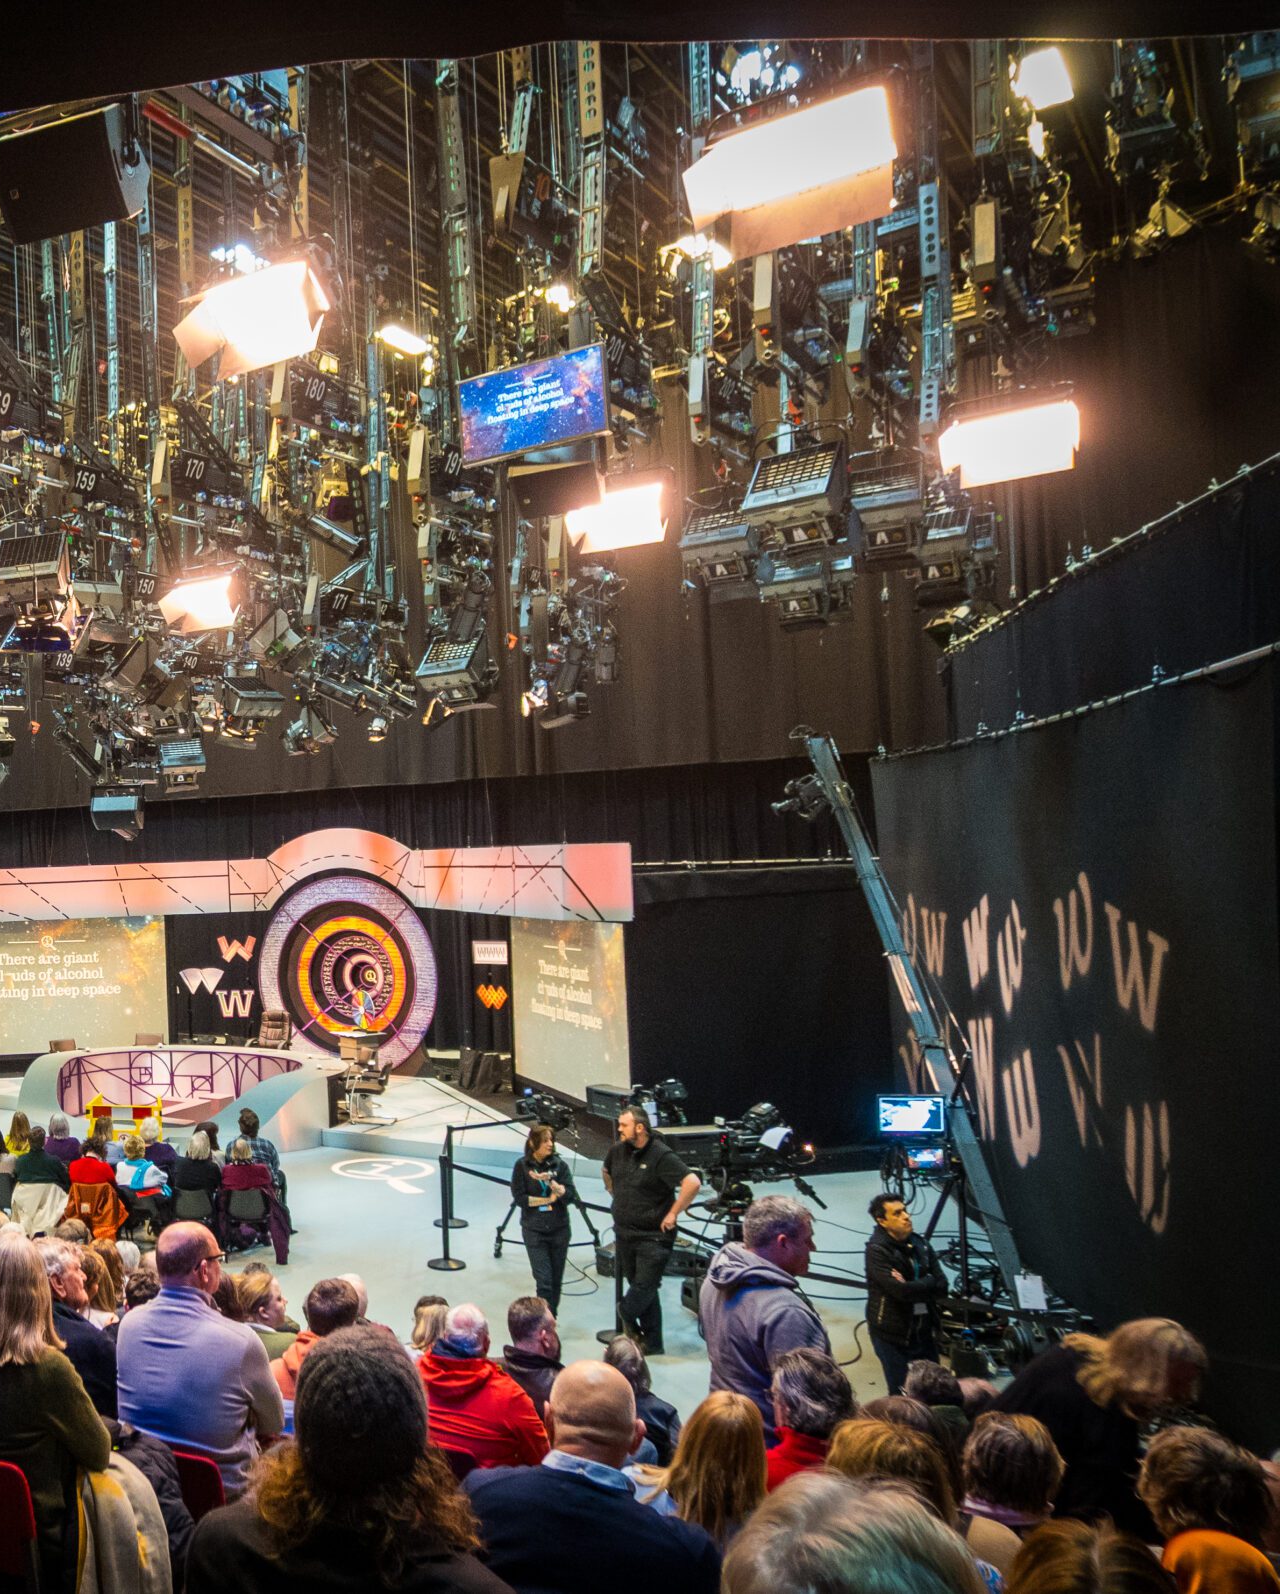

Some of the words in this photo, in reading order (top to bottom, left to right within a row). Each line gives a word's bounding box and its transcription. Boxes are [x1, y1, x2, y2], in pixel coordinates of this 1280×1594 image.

[305, 377, 326, 401] 180
[496, 400, 522, 412] cluds
[524, 396, 533, 406] of
[534, 388, 564, 402] alcohol
[498, 391, 522, 402] There
[523, 387, 537, 396] are
[538, 379, 561, 394] giant
[487, 411, 519, 424] floating
[520, 408, 529, 416] in
[529, 403, 549, 413] deep
[550, 397, 575, 409] space
[184, 457, 205, 480] 170
[445, 452, 462, 476] 191
[75, 470, 96, 491] 159
[138, 577, 155, 594] 150
[332, 593, 348, 610] 171
[56, 653, 72, 667] 139
[183, 656, 197, 669] 140
[38, 954, 60, 964] are
[64, 952, 99, 967] giant
[217, 935, 256, 963] W
[38, 969, 53, 983] of
[55, 968, 104, 981] alcohol
[1105, 901, 1169, 1033] W
[32, 985, 46, 997] in
[48, 984, 79, 998] deep
[83, 984, 121, 996] space
[215, 990, 254, 1018] W
